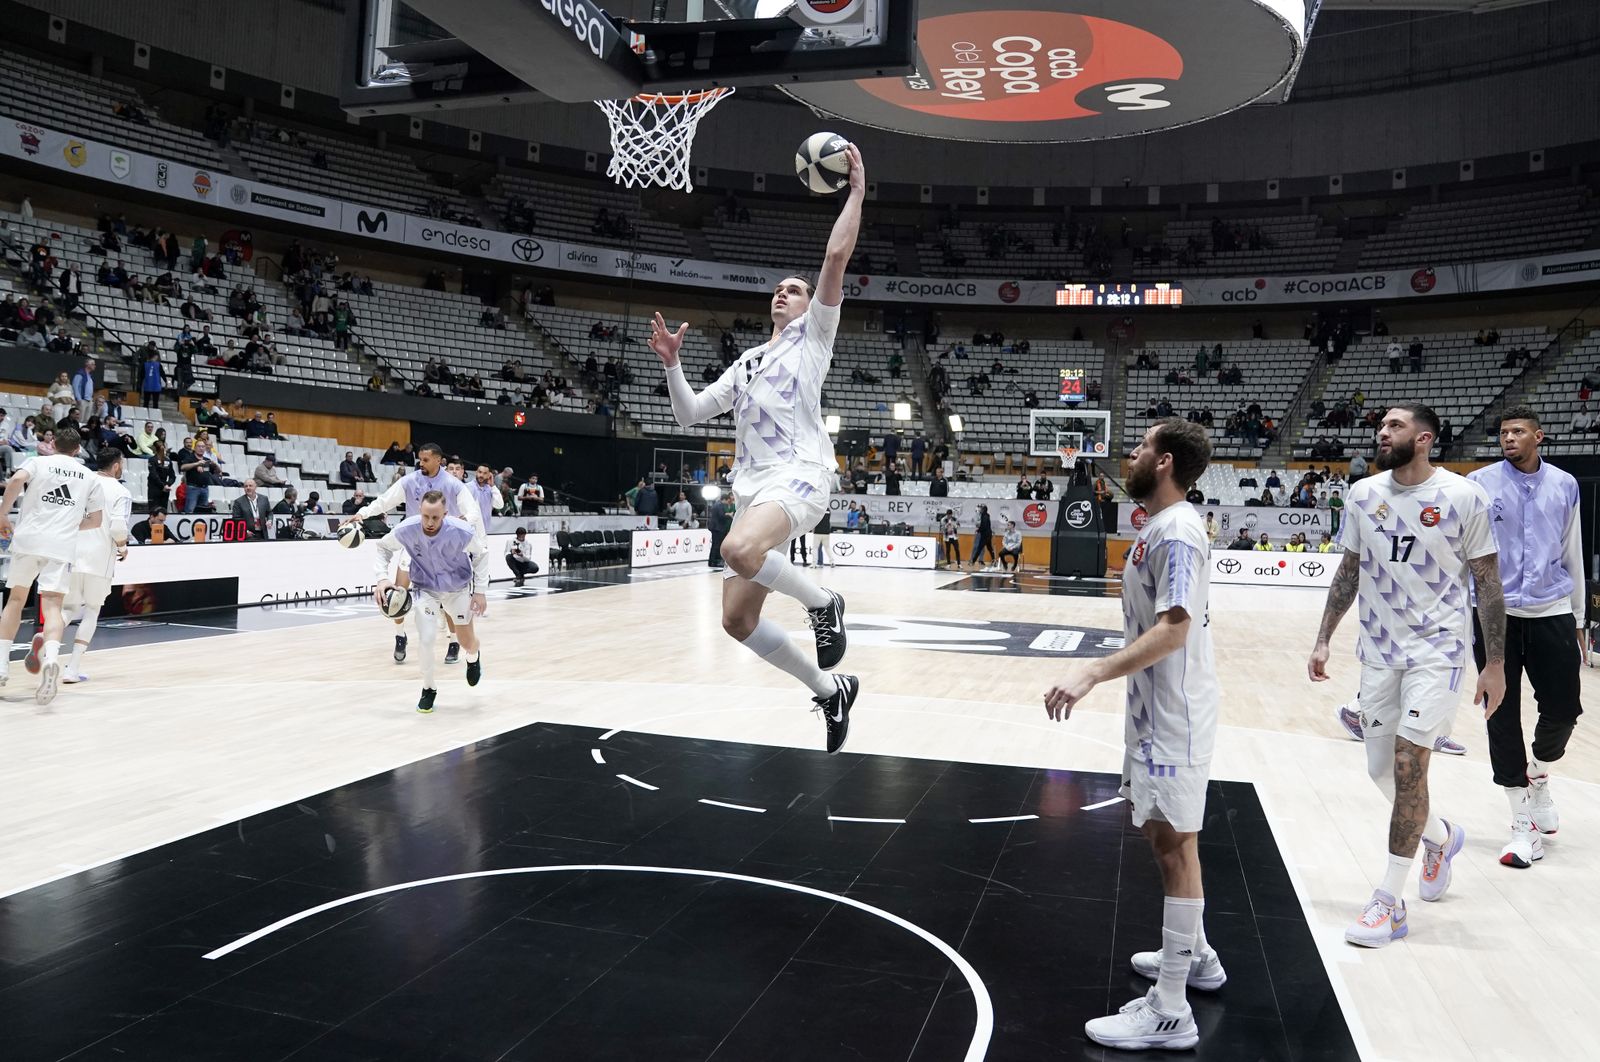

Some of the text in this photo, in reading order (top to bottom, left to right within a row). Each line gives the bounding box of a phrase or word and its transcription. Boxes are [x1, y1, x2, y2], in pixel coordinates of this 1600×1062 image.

[990, 36, 1042, 93] Copa
[1048, 48, 1083, 79] acb
[940, 42, 986, 101] del Rey
[422, 229, 490, 252] endesa
[567, 251, 598, 263] divina
[615, 257, 657, 274] SPALDING
[670, 269, 699, 279] Halcón
[729, 275, 766, 286] MONDO
[841, 285, 862, 297] cb
[885, 280, 977, 297] #CopaACB
[1284, 276, 1386, 295] #CopaACB
[1221, 288, 1258, 301] acb
[1062, 380, 1081, 394] 24
[41, 495, 76, 507] adidas
[888, 501, 913, 513] REY
[1278, 513, 1321, 525] COPA
[866, 550, 889, 559] acb
[1389, 535, 1417, 564] 17
[1254, 566, 1281, 576] acb
